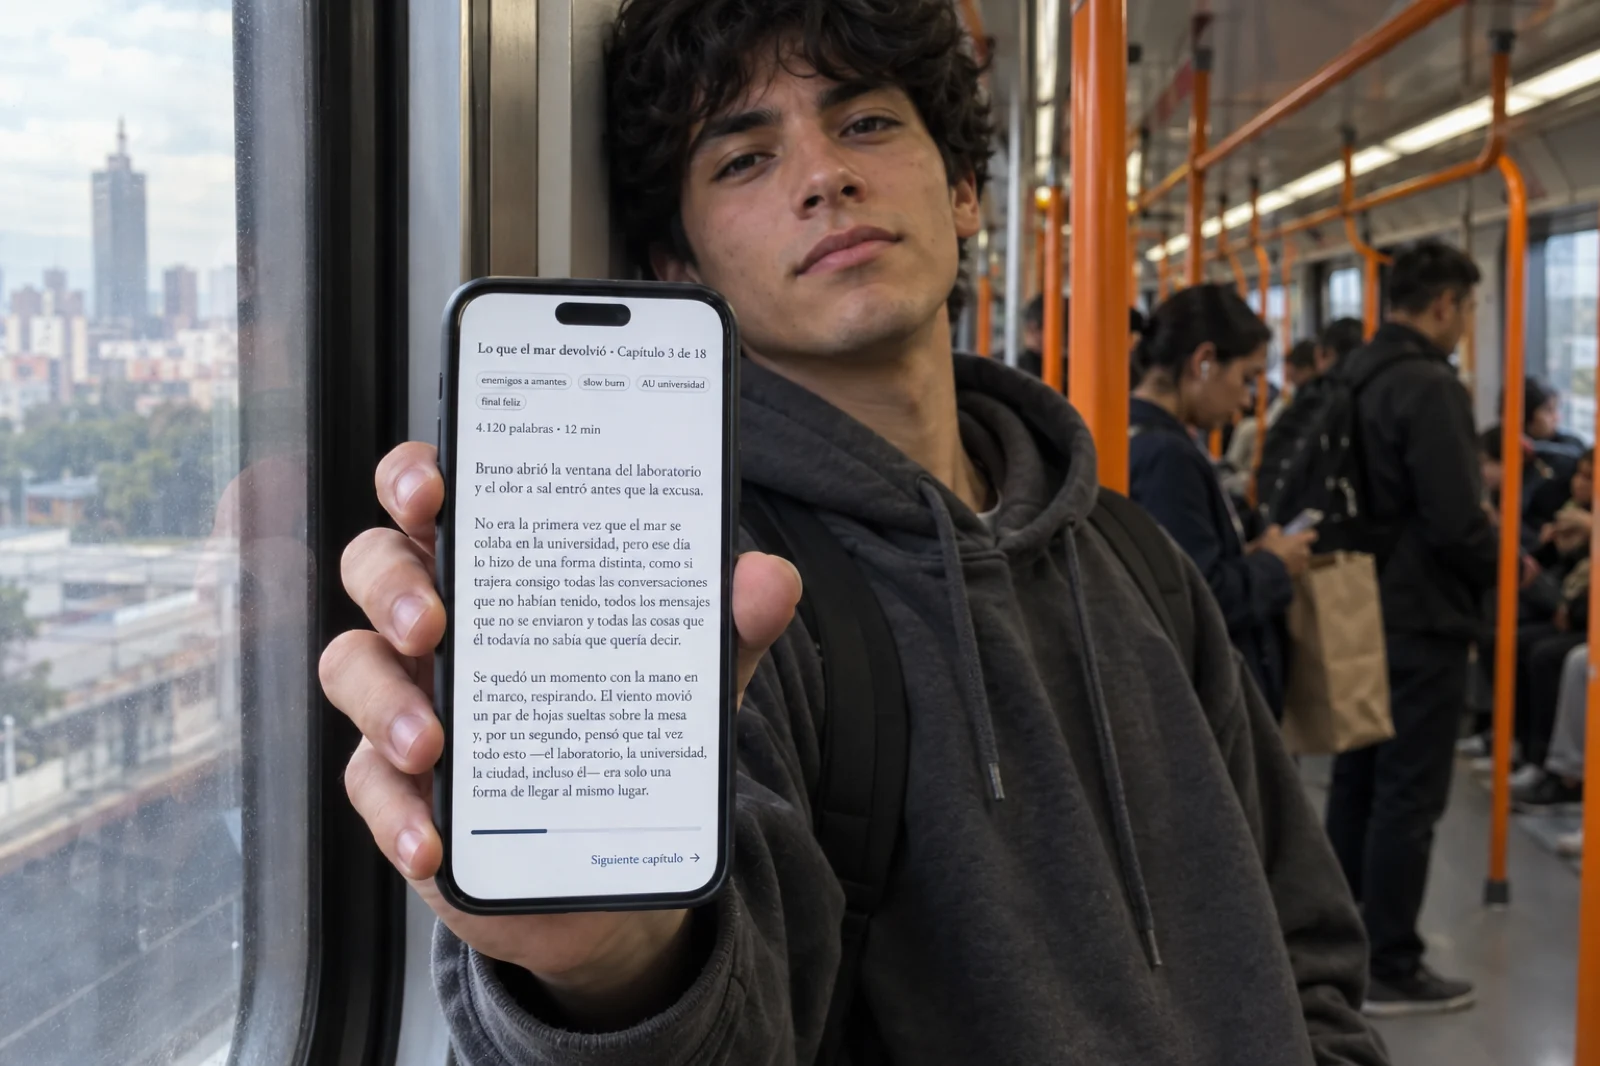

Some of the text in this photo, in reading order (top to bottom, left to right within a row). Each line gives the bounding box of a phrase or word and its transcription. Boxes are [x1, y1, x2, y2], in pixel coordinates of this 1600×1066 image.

[478, 342, 707, 360] Lo que el mar devolvió Capítulo 3 de 18
[481, 376, 522, 387] enemigos
[531, 378, 567, 386] amantes
[583, 378, 625, 387] slow burn
[641, 379, 705, 389] AU universidad
[481, 396, 521, 407] final feliz
[475, 422, 601, 436] 4.120 palabras 12 min
[475, 462, 702, 478] Bruno abrió la ventana del laboratorio
[474, 480, 704, 499] y el olor a sal entró antes que la excusa.
[474, 517, 682, 534] No era la primera vez que el mar se
[474, 536, 691, 554] colaba en la universidad, pero ese día
[474, 555, 693, 570] lo hizo de una forma distinta, como si
[474, 574, 708, 591] trajera consigo todas las conversaciones
[473, 594, 711, 610] que no habían tenido, todos los mensajes
[473, 613, 704, 630] que no se enviaron y todas las cosas que
[473, 632, 681, 650] él todavía no sabía que quería decir.
[473, 670, 698, 686] Se quedó un momento con la mano en
[472, 689, 692, 706] el marco, respirando. El viento movió
[473, 708, 687, 725] un par de hojas sueltas sobre la mesa
[472, 727, 684, 744] y, por un segundo, pensó que tal vez
[472, 747, 500, 760] todo
[502, 750, 527, 760] esto
[557, 747, 623, 760] laboratorio,
[626, 746, 637, 759] la
[640, 745, 707, 760] universidad,
[472, 766, 483, 779] la
[486, 766, 529, 780] ciudad,
[532, 765, 574, 779] incluso
[603, 769, 621, 778] era
[624, 764, 648, 778] solo
[650, 768, 672, 778] una
[472, 784, 649, 801] forma de llegar al mismo lugar.
[590, 852, 684, 868] Siguiente capítulo
